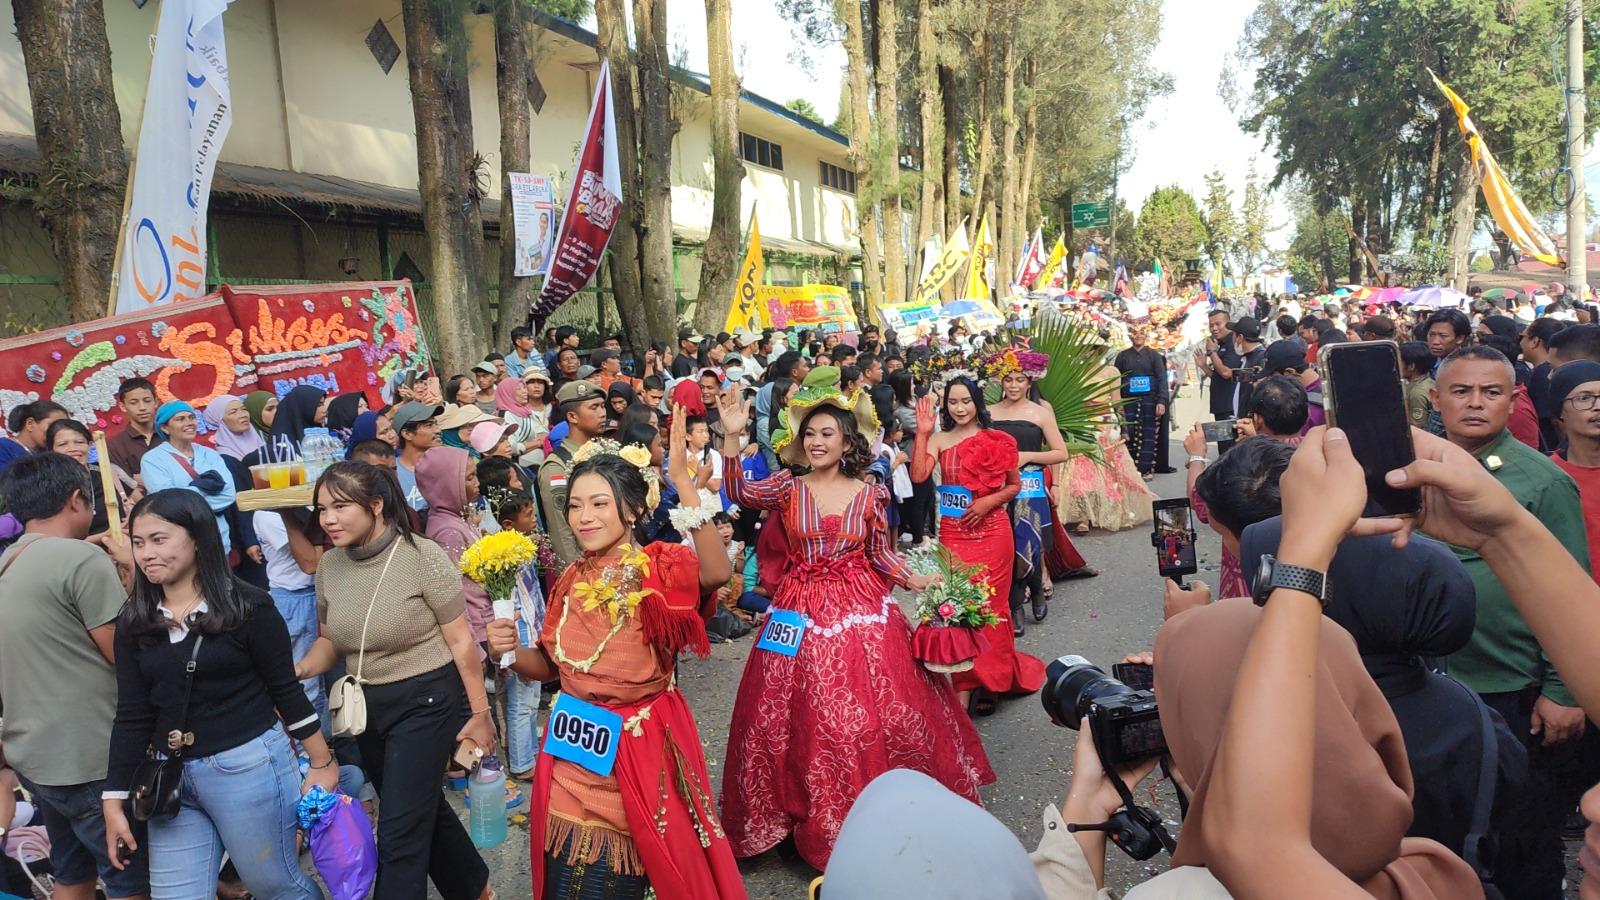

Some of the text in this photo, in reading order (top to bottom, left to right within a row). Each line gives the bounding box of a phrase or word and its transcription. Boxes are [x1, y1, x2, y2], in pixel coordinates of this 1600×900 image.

[195, 103, 228, 176] Pelayanan
[1021, 478, 1040, 491] 949
[942, 492, 968, 509] 0946
[767, 621, 798, 646] 0951
[553, 711, 611, 757] 0950
